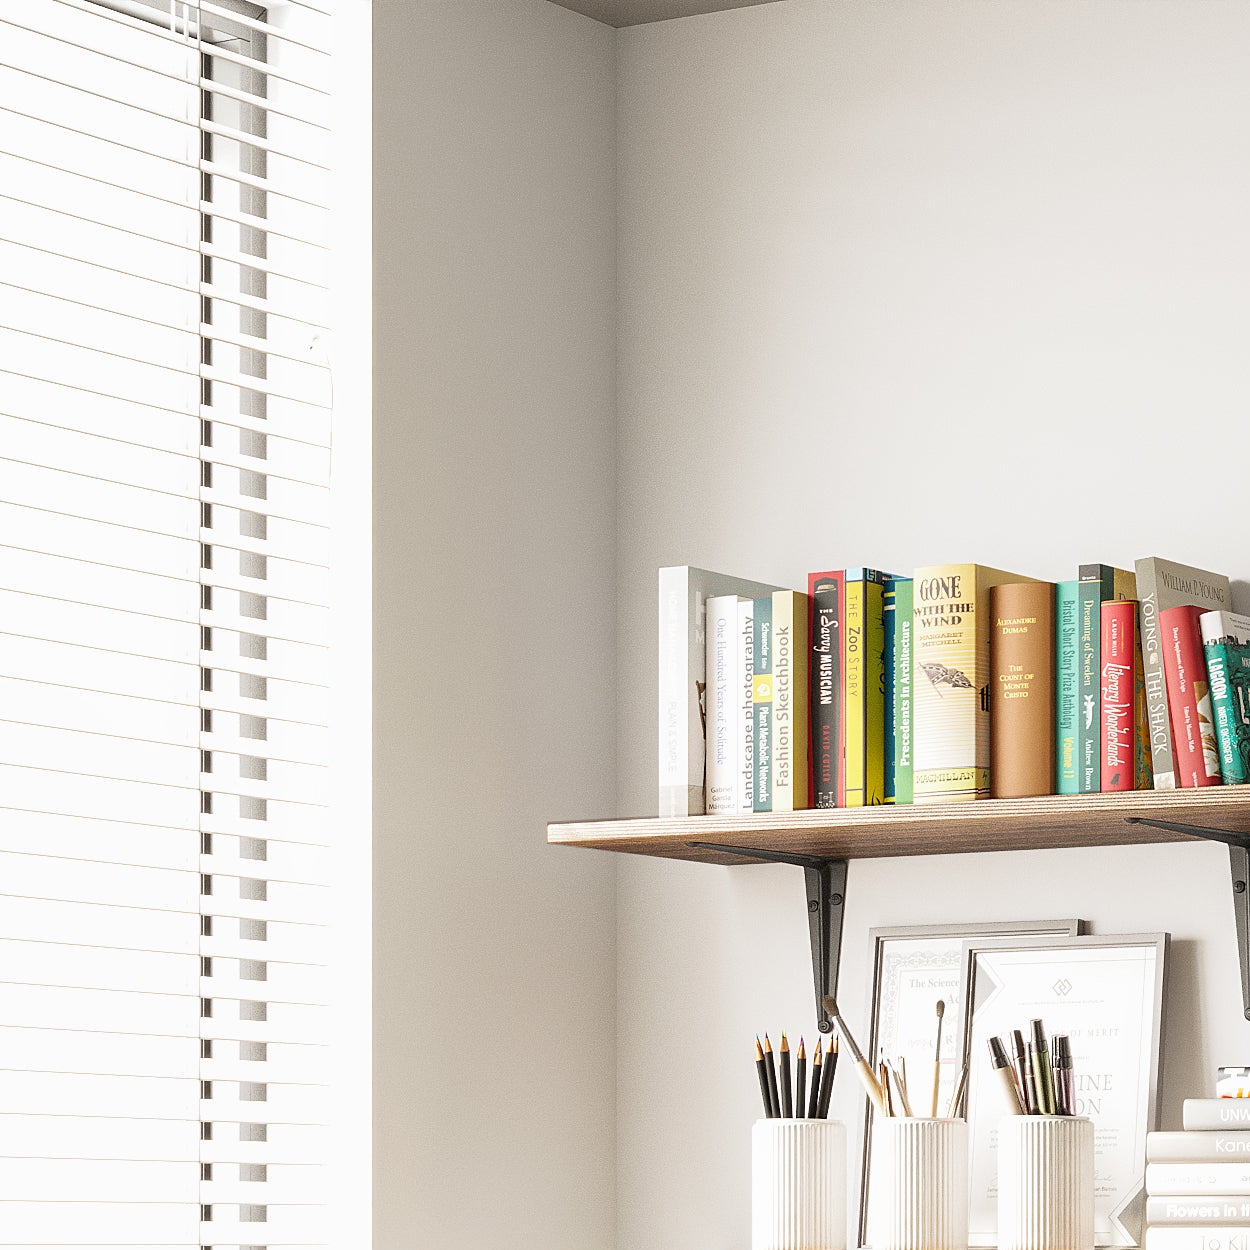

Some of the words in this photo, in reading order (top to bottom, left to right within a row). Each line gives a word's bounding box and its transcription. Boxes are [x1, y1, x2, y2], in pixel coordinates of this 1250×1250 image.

[919, 576, 962, 602] GONE
[1161, 571, 1191, 595] WILLIAM
[1200, 581, 1224, 603] YOUNG
[848, 595, 857, 618] THE
[914, 604, 947, 617] WITH
[949, 603, 974, 614] THE
[1062, 600, 1075, 625] Bristol
[717, 618, 727, 639] One
[921, 616, 962, 628] WIND
[996, 617, 1037, 627] ALEXANDRE
[1003, 625, 1028, 634] DUMAS
[1081, 600, 1094, 641] Dreaming
[1141, 593, 1158, 652] YOUNG
[761, 622, 769, 656] Schwender
[813, 615, 839, 653] Savvy
[919, 632, 964, 641] MARGARET
[921, 639, 963, 647] MITCHELL
[1062, 628, 1075, 648] Short
[900, 621, 910, 685] Architecture
[1060, 651, 1075, 669] Story
[1084, 643, 1095, 652] of
[716, 641, 727, 682] Hundred
[742, 616, 754, 720] photography
[776, 626, 789, 721] Sketchbook
[1084, 653, 1094, 686] Sweden
[820, 654, 832, 705] MUSICIAN
[999, 673, 1022, 681] COUNT
[1024, 673, 1034, 681] OF
[1003, 682, 1029, 690] MONTE
[1062, 673, 1074, 691] Prize
[1102, 662, 1130, 703] Literary
[1148, 667, 1163, 701] THE
[1207, 657, 1228, 701] LAGOON
[716, 684, 727, 709] Years
[900, 687, 910, 698] in
[1004, 690, 1028, 698] CRISTO
[717, 711, 727, 723] of
[760, 707, 769, 728] Plant
[1060, 694, 1074, 730] Anthology
[822, 725, 830, 750] DAVID
[900, 700, 910, 766] Precedents
[1104, 703, 1130, 767] Wonderlands
[1151, 703, 1168, 756] SHACK
[717, 726, 727, 765] Solitude
[759, 728, 768, 764] Metabolic
[776, 726, 789, 787] Fashion
[1063, 737, 1074, 767] Volume
[1085, 738, 1094, 765] Andrew
[742, 725, 753, 809] Landscape
[822, 753, 830, 782] CUTLER
[916, 772, 975, 784] MACMILLAN
[1085, 767, 1094, 790] Brown
[759, 766, 768, 802] Networks
[909, 978, 925, 989] The
[927, 977, 960, 988] Science
[1087, 1027, 1120, 1038] MERIT
[1166, 1205, 1221, 1218] Flowers
[1223, 1205, 1237, 1217] in
[1200, 1235, 1221, 1250] To
